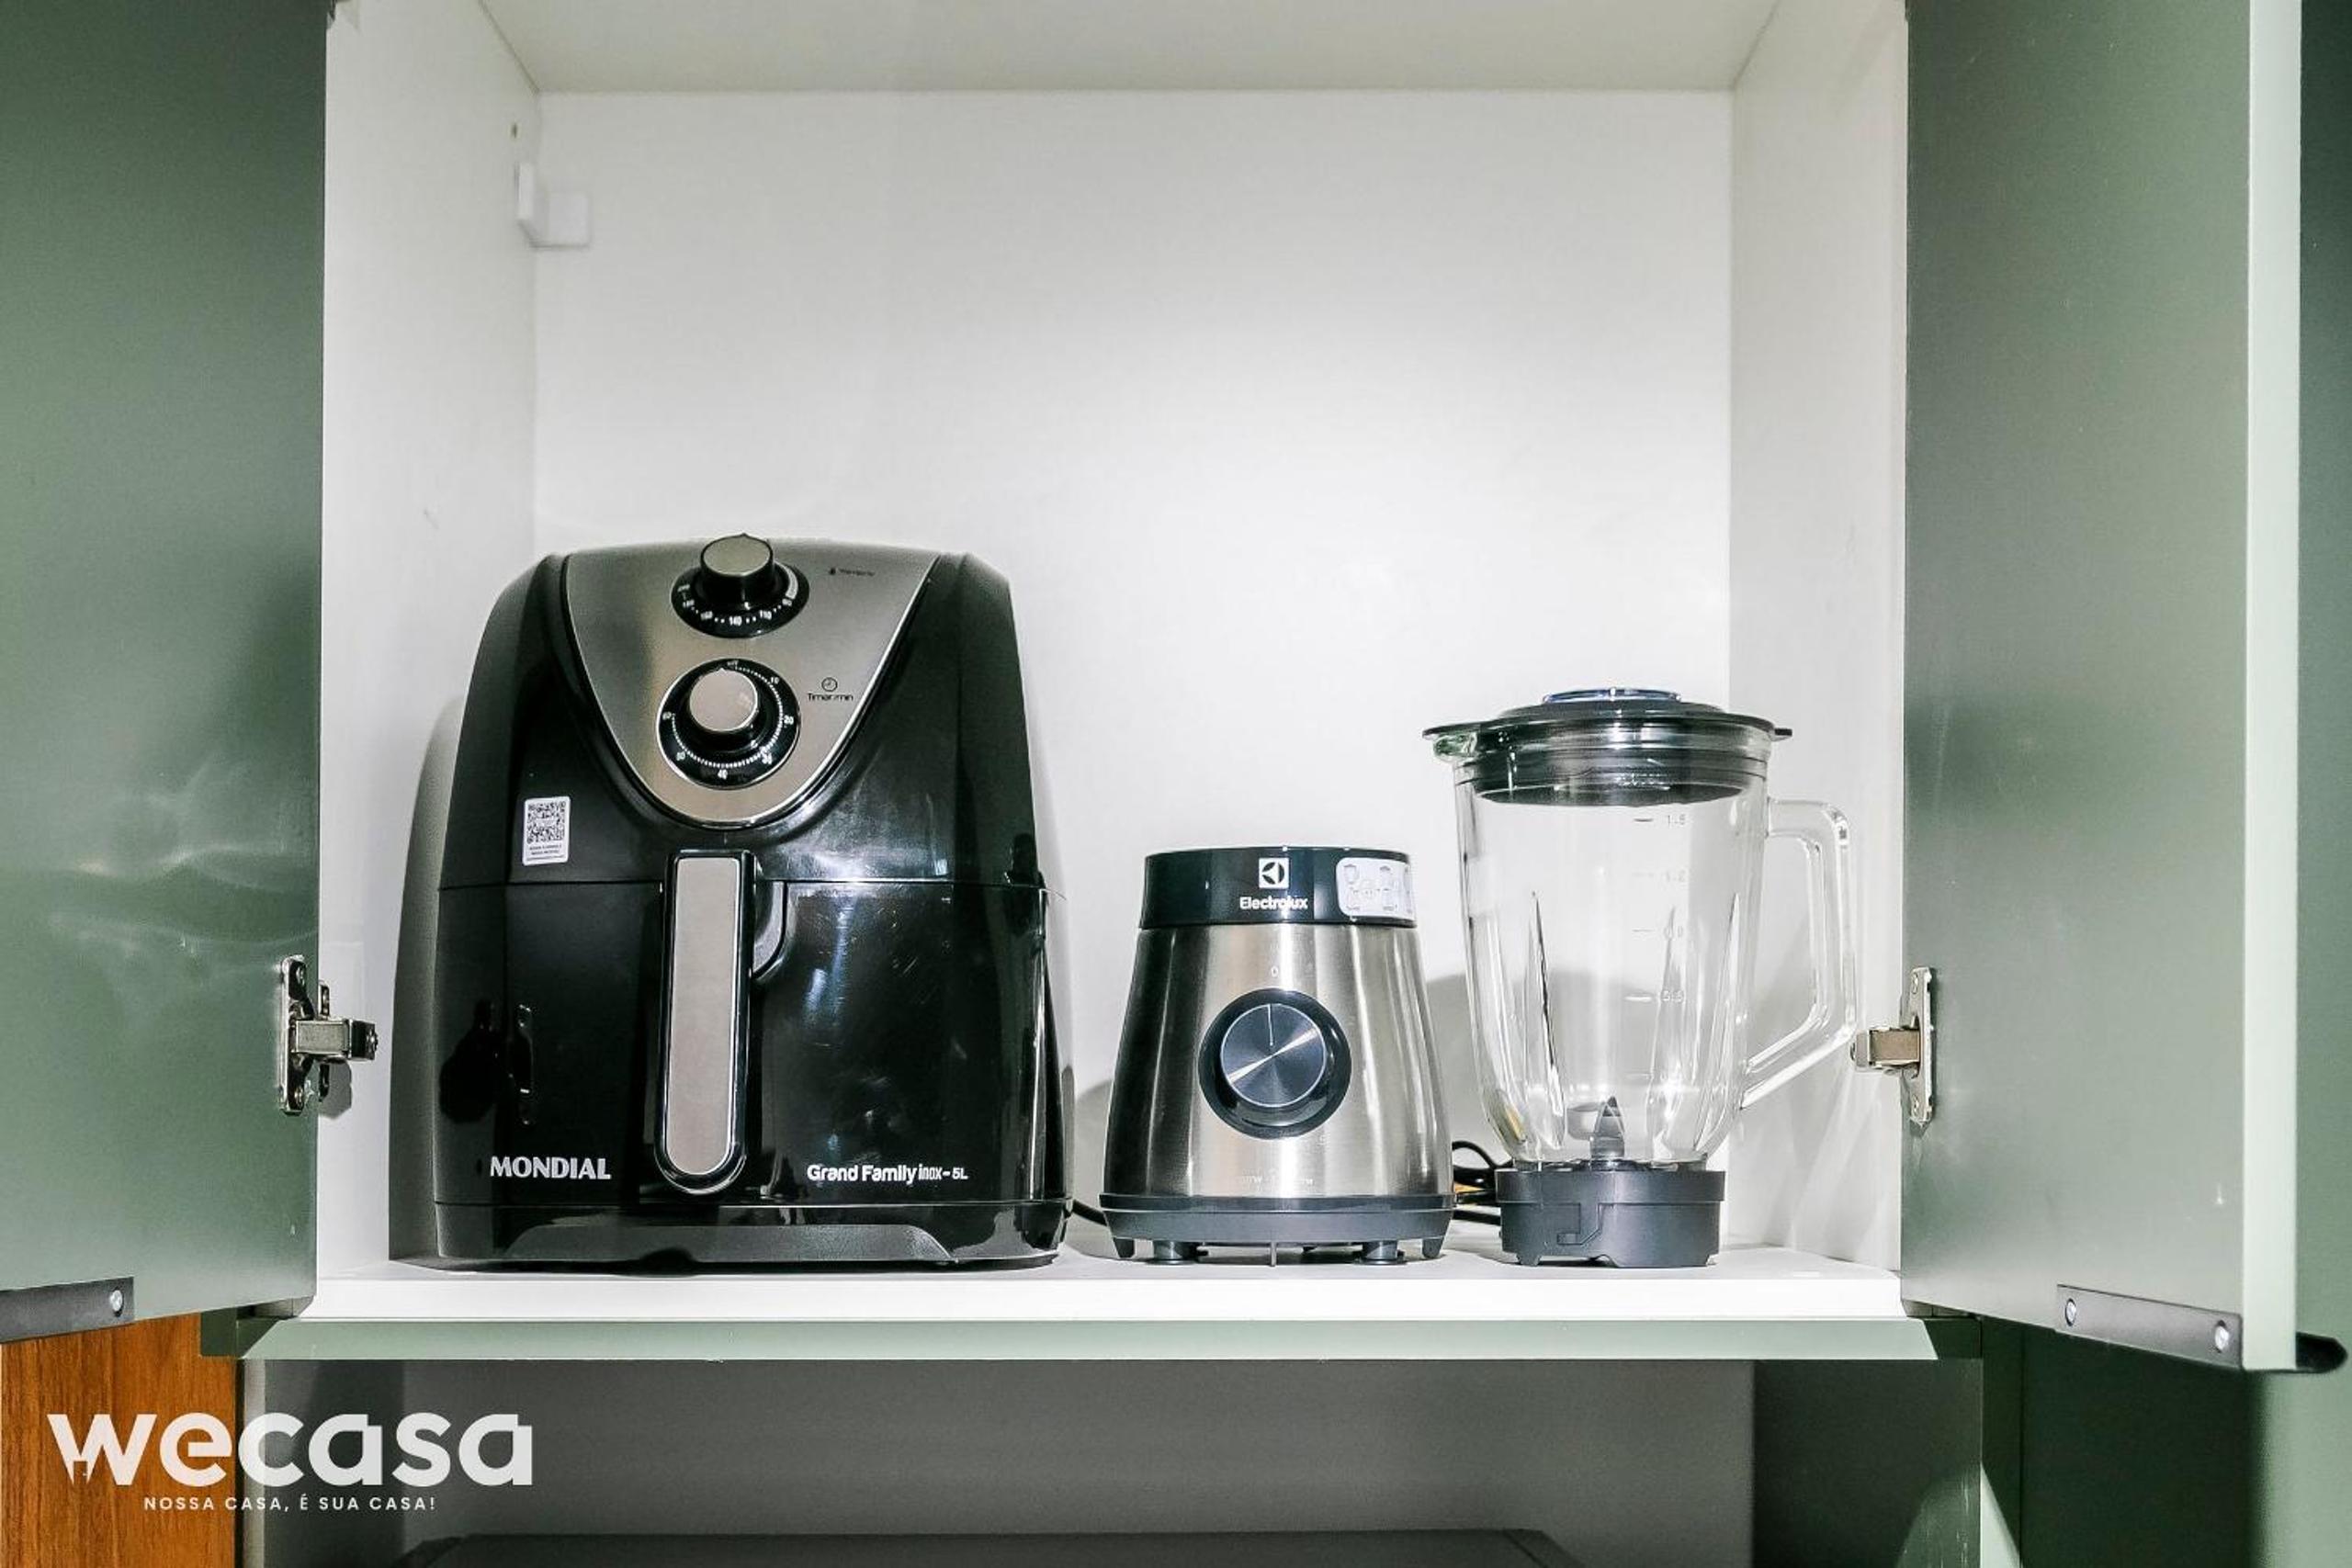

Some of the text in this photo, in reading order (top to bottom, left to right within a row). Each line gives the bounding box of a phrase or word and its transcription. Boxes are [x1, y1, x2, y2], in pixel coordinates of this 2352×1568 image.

[770, 676, 780, 684] 10
[1239, 896, 1308, 910] Electrolux
[490, 1156, 612, 1179] MONDIAL
[807, 1164, 859, 1182] Grand
[862, 1164, 917, 1185] Family
